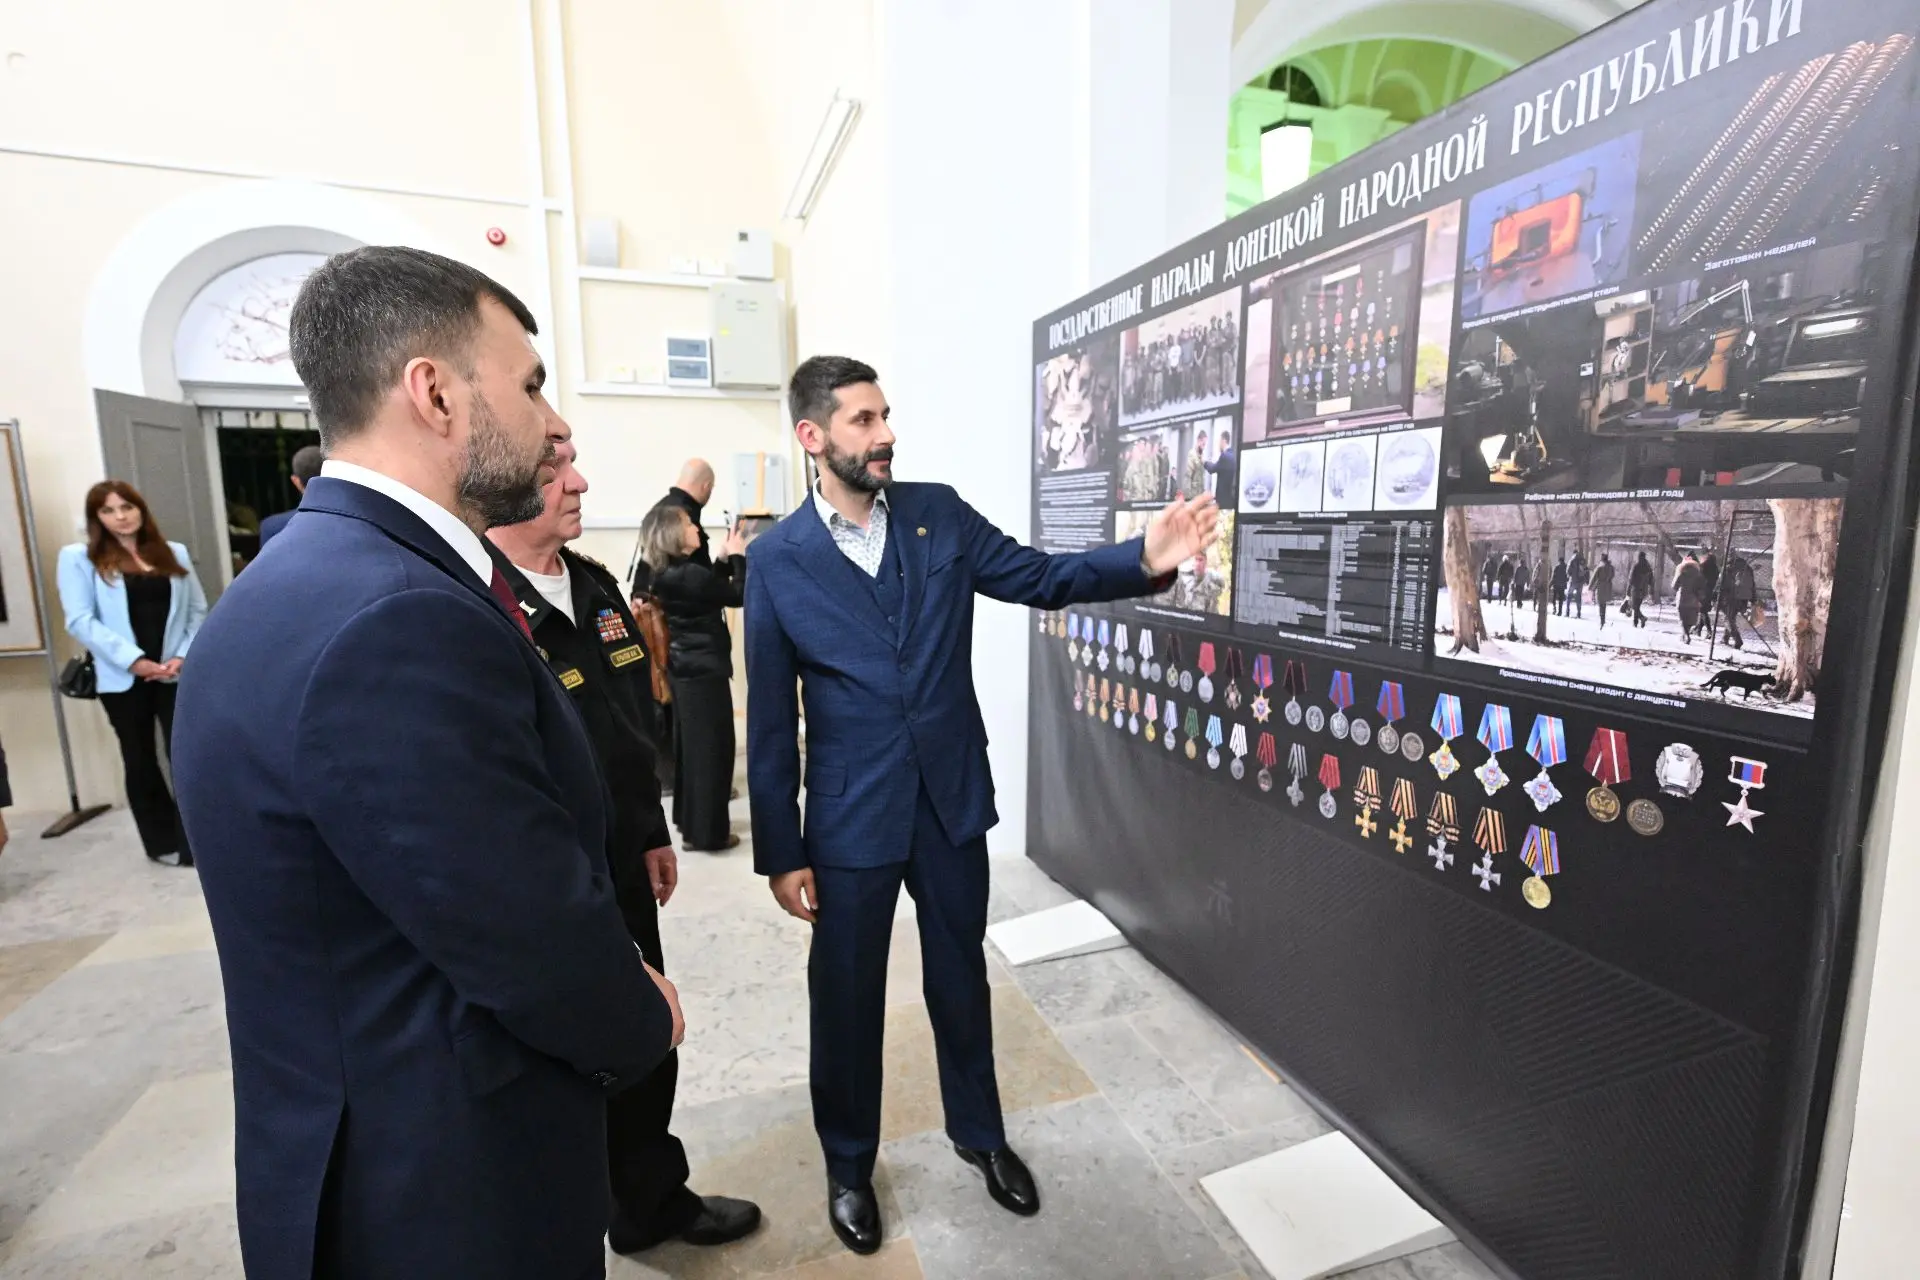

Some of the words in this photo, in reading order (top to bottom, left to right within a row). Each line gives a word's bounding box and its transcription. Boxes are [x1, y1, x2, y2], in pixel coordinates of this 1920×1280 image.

[1151, 250, 1215, 308] НАГРАДЫ
[1223, 192, 1325, 283] ДОНЕЦКОЙ
[1339, 113, 1489, 228] НАРОДНОЙ
[1510, 0, 1804, 155] РЕСПУБЛИКИ
[1703, 251, 1762, 271] Заготовки
[1763, 236, 1818, 258] медалей
[1524, 493, 1556, 501] Рабочее
[1556, 492, 1580, 501] место
[1660, 489, 1685, 499] году
[1499, 668, 1569, 688] Производственная
[1568, 682, 1595, 693] смена
[1594, 686, 1627, 699] уходит
[1626, 692, 1634, 700] с
[1633, 694, 1687, 709] дежурства
